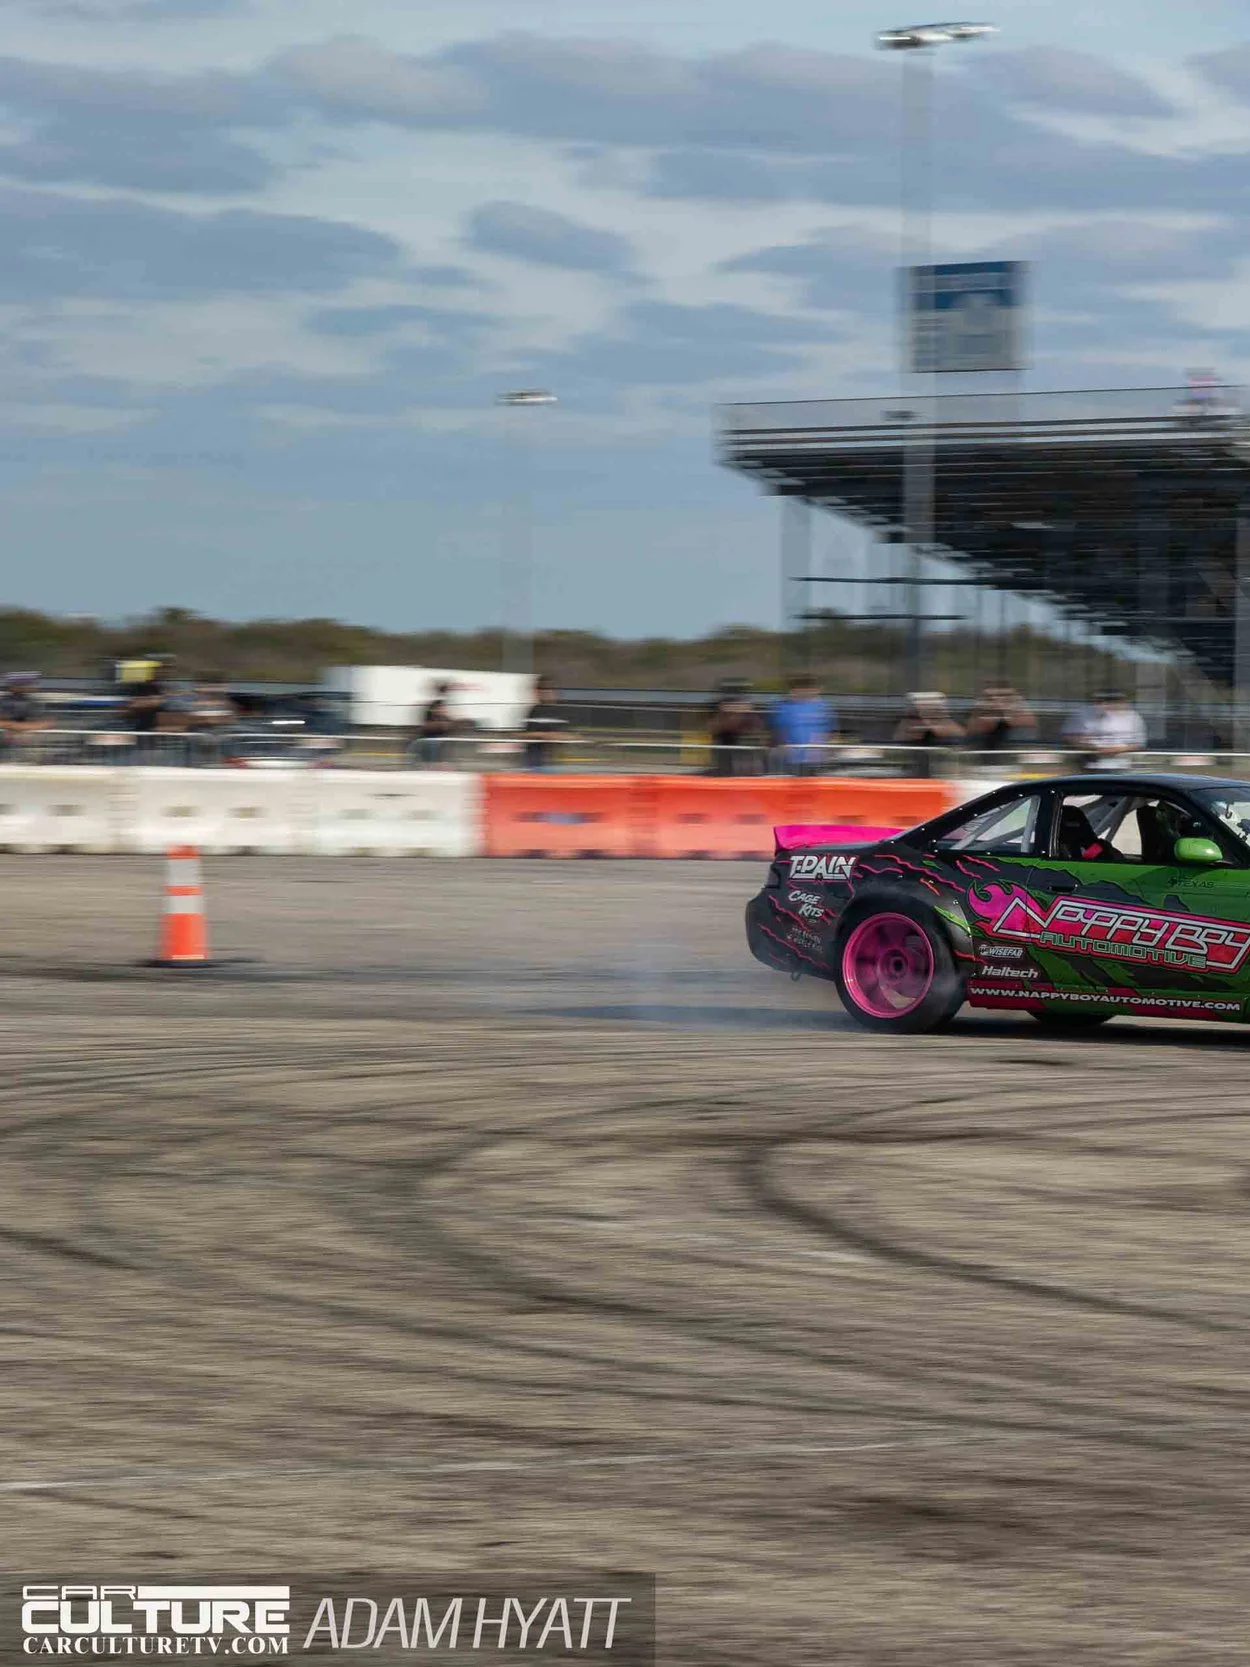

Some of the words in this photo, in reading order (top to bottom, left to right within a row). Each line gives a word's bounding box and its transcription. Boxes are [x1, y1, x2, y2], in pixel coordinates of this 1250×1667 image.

[788, 890, 821, 904] CAGE
[1040, 931, 1208, 969] AUTOMOTIVE
[981, 965, 1039, 978] Haltech
[969, 987, 1241, 1011] WWW.NAPPYBOYAUTOMOTIVE.COM
